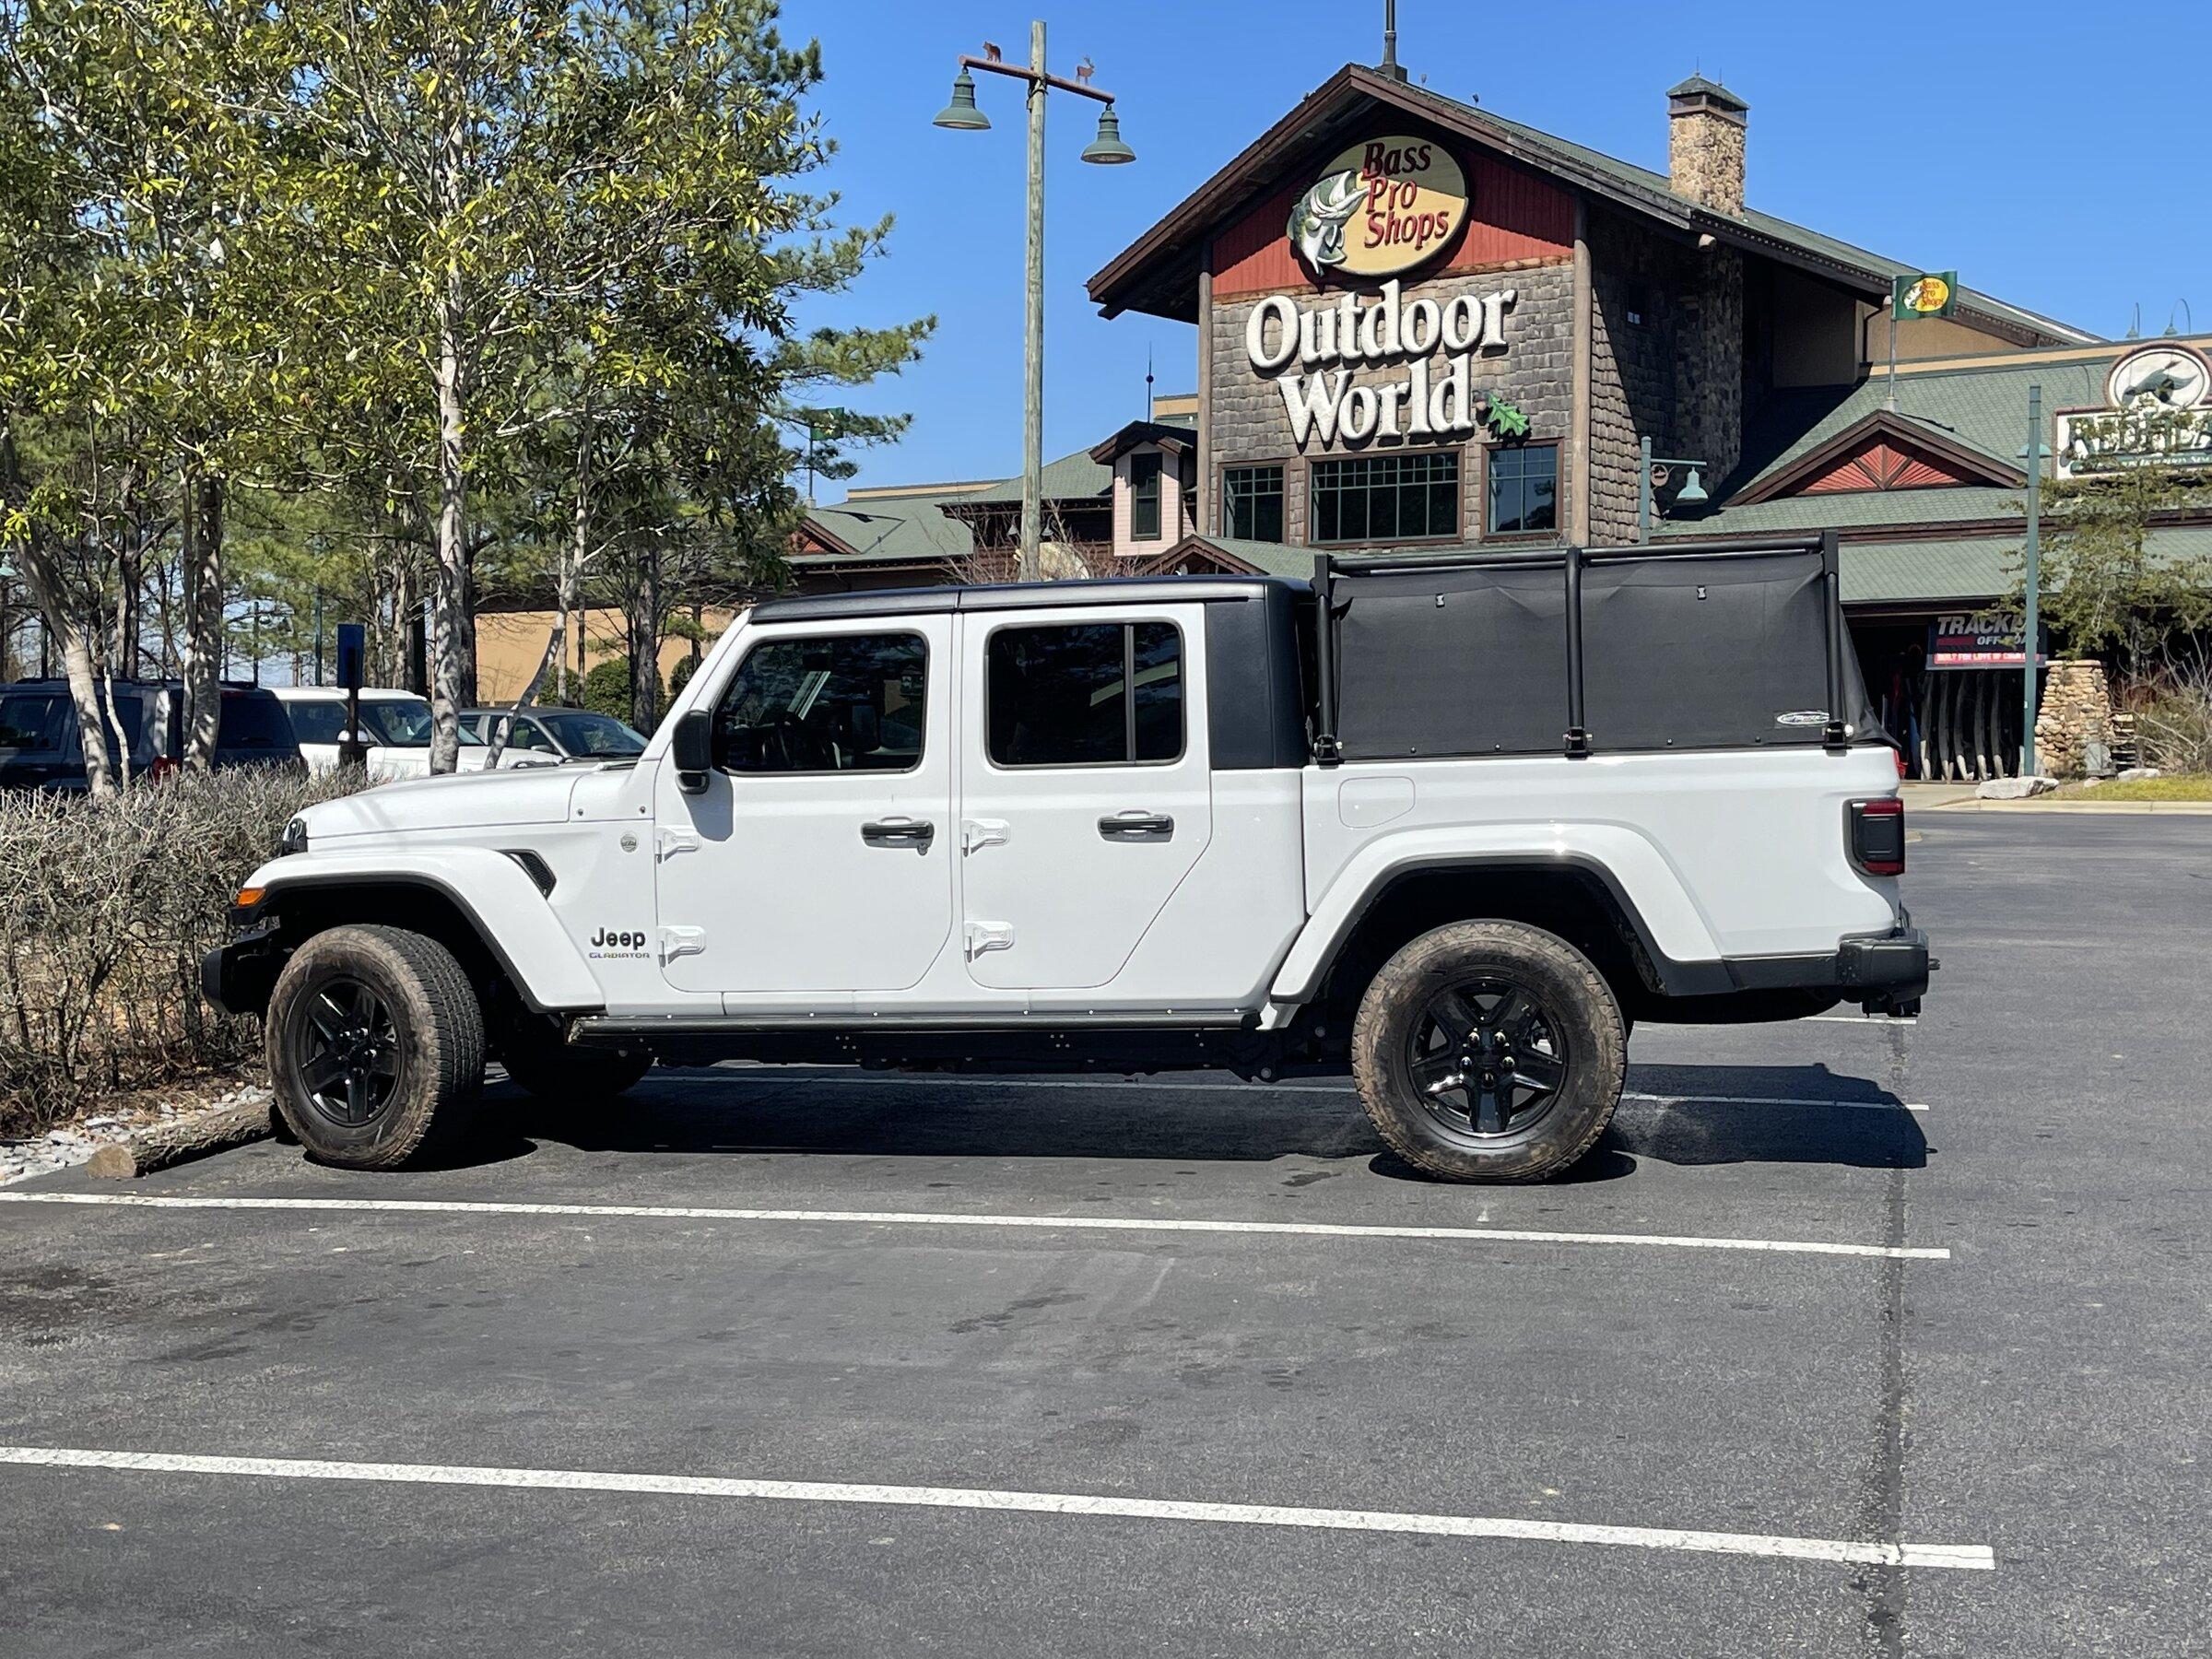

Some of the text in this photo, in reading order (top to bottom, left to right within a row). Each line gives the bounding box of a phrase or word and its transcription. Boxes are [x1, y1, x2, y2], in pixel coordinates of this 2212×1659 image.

[1361, 142, 1431, 182] Bass
[1366, 176, 1418, 214] Pro
[1364, 210, 1450, 251] Shops
[1246, 278, 1518, 368] Outdoor
[1277, 353, 1473, 445] World
[1937, 612, 2030, 636] TRACKE
[1977, 636, 2001, 645] OFF
[591, 927, 646, 950] Jeep
